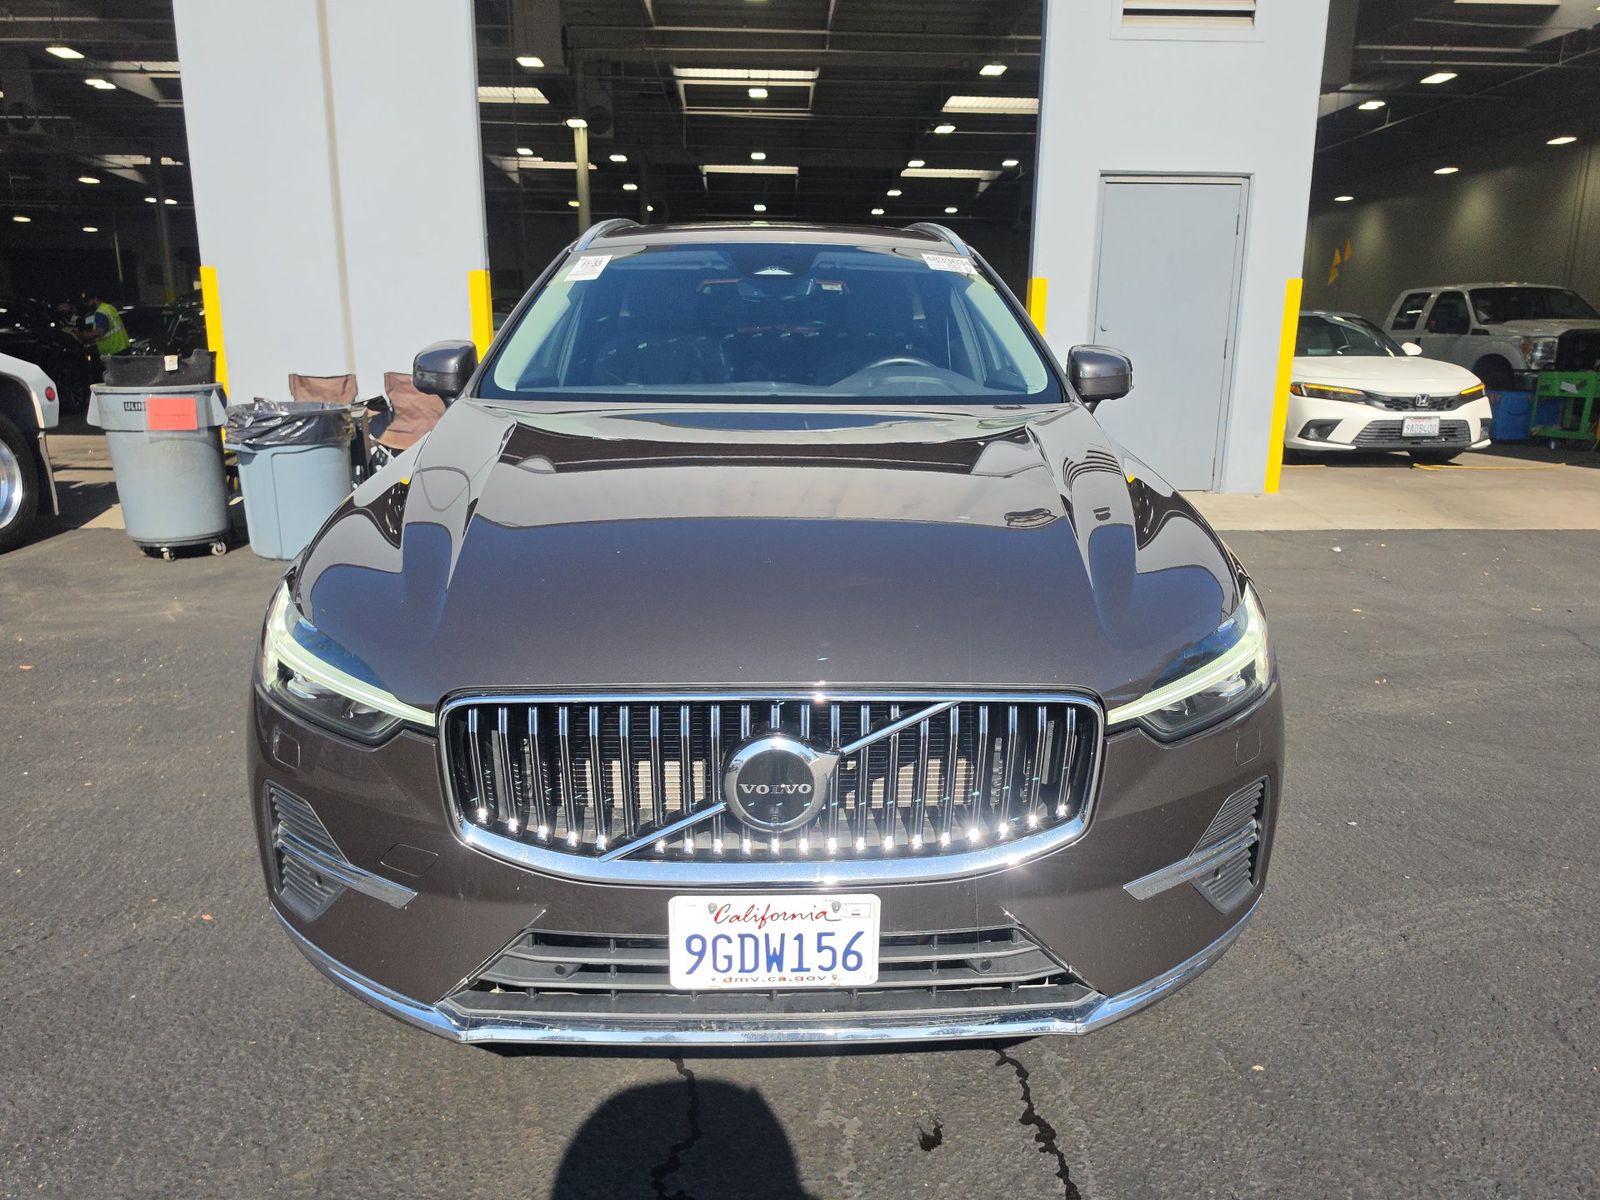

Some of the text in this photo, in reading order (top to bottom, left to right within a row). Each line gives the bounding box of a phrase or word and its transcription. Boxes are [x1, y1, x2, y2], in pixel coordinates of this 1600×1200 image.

[125, 402, 146, 410] ULIN
[739, 783, 812, 794] VOLVO
[714, 903, 841, 929] California
[685, 931, 865, 975] 9GDW156
[723, 974, 827, 983] dmv.ca.gov
